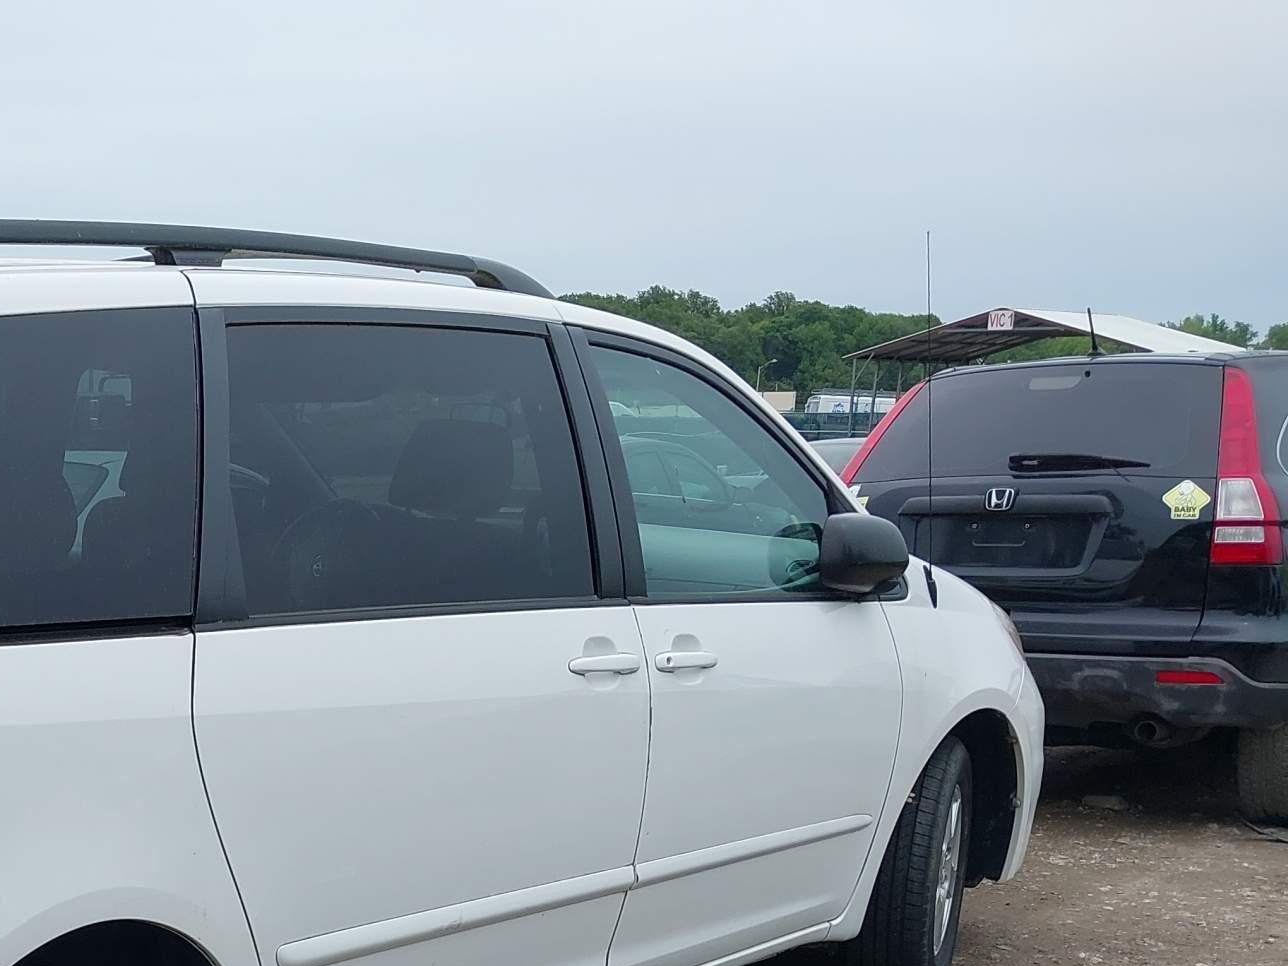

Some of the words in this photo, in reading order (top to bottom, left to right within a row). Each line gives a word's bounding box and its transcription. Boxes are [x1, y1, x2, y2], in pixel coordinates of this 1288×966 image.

[989, 312, 1006, 328] VIC
[1007, 312, 1014, 328] 1
[1173, 505, 1197, 513] BABY
